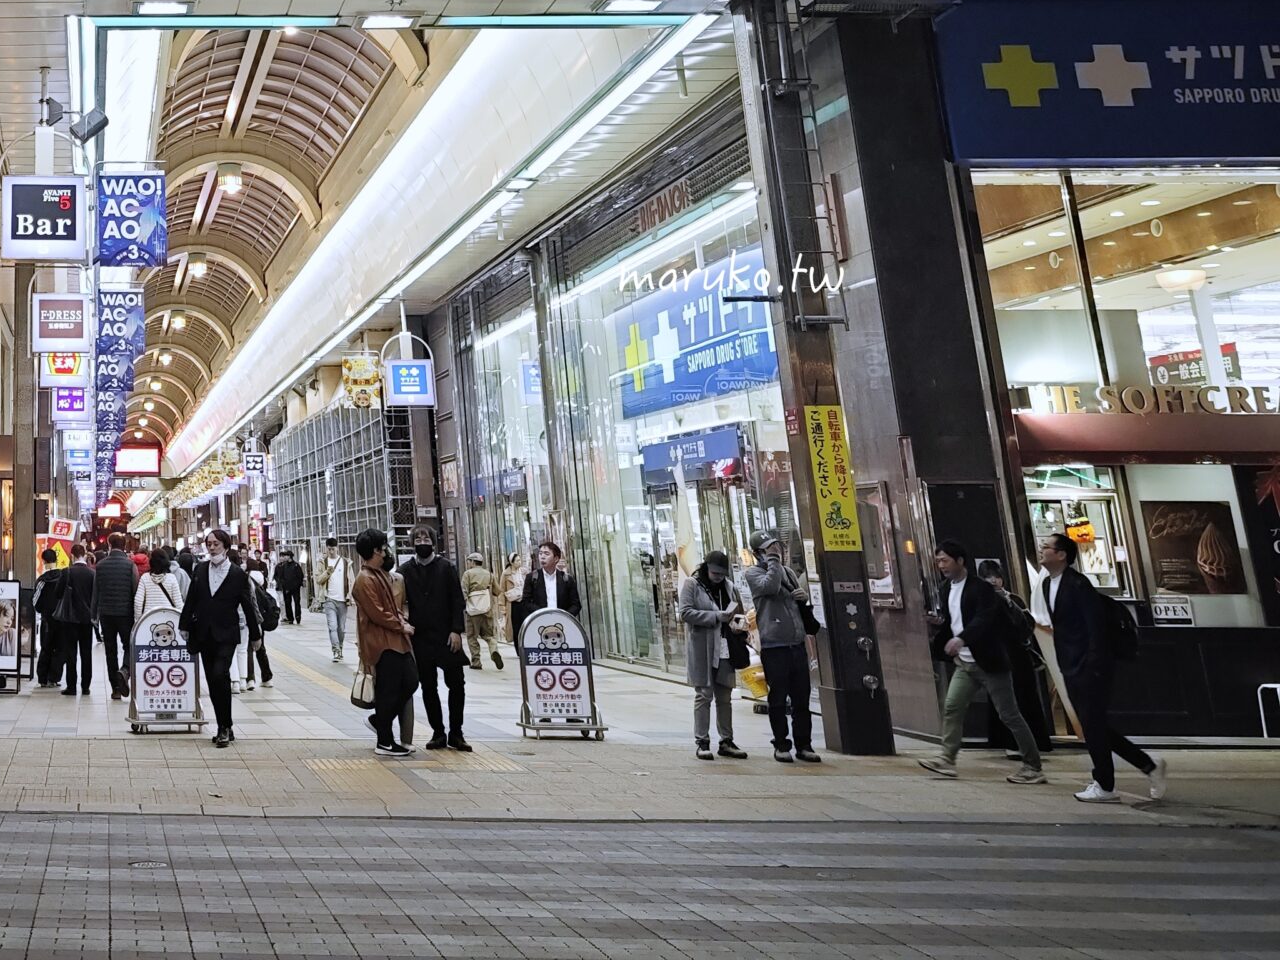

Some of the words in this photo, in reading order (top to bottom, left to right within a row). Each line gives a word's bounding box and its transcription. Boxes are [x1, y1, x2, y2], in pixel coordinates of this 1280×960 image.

[1173, 88, 1246, 104] SAPPORO
[42, 189, 71, 197] AVANTI
[100, 177, 162, 196] WAO!
[59, 195, 71, 211] 5
[15, 214, 72, 236] Bar
[101, 220, 140, 240] AO
[100, 293, 143, 306] WAO!
[101, 322, 127, 337] AO
[687, 346, 716, 374] SAPPORO
[716, 342, 735, 366] DRUG
[736, 334, 759, 359] STORE
[97, 363, 119, 376] AO
[1096, 384, 1280, 416] SOFTCRE
[810, 410, 833, 499] ご通行ください
[826, 409, 849, 498] 自転車から降りて
[138, 649, 191, 661] 歩行者専用
[528, 651, 583, 665] 歩行者専用
